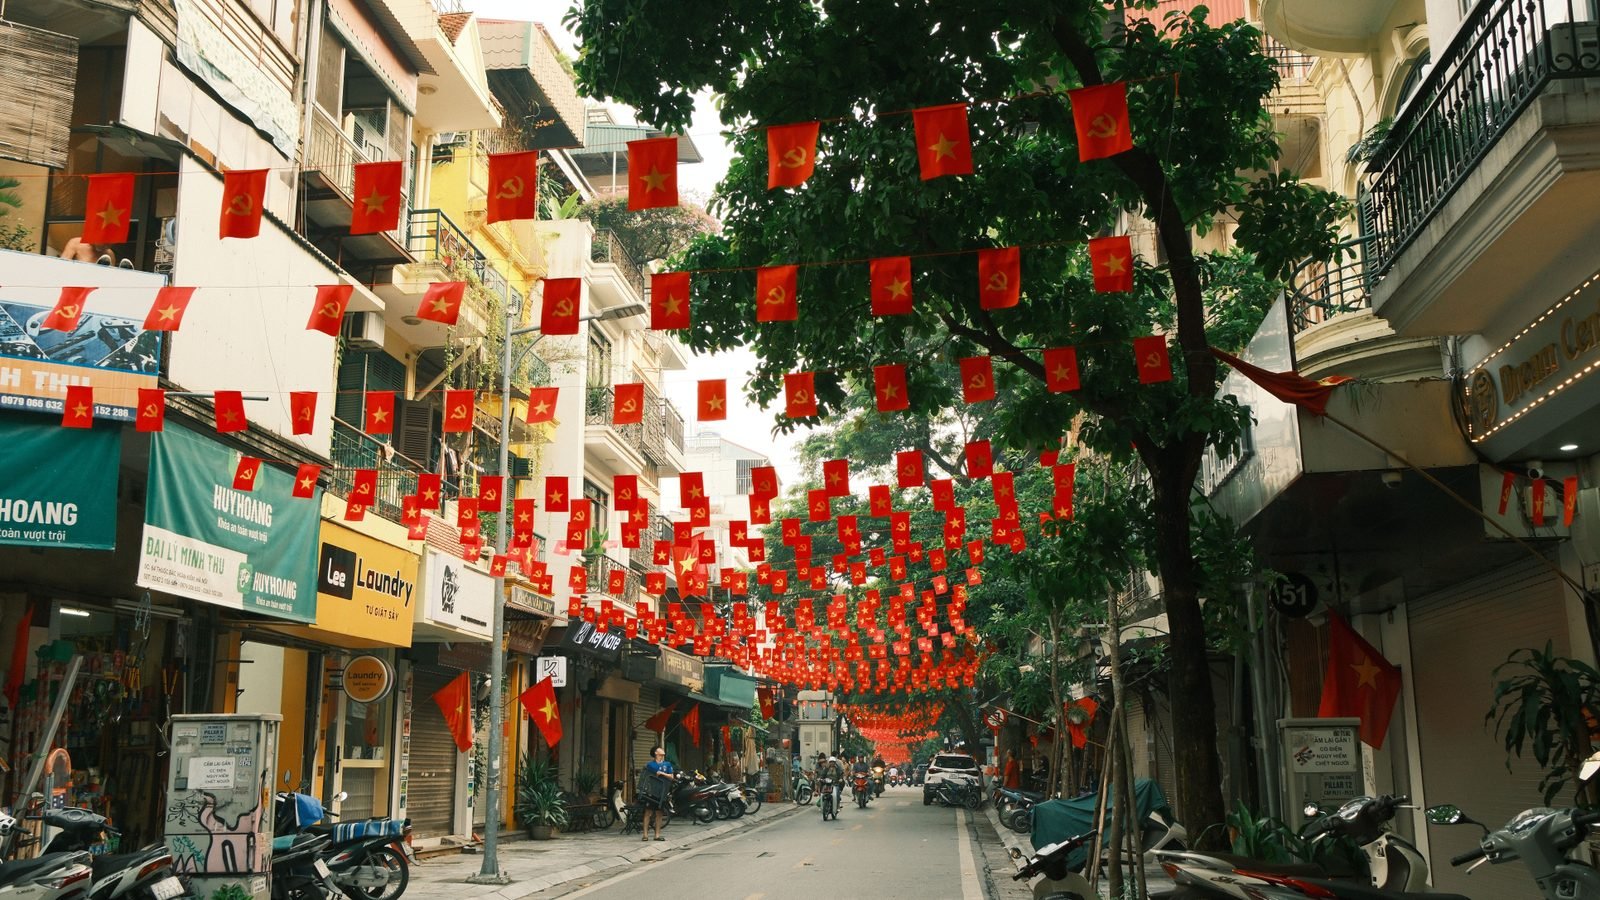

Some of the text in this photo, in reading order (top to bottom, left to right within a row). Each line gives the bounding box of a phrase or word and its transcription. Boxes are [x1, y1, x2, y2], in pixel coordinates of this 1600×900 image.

[1499, 304, 1600, 405] Dream Cen
[0, 395, 24, 406] 0979
[45, 400, 63, 410] 632
[94, 405, 111, 417] 152
[213, 484, 273, 528] HUYHOANG
[23, 530, 46, 542] vượt
[48, 531, 66, 543] trội
[145, 536, 165, 563] ĐẠI
[180, 546, 205, 571] MINH
[207, 554, 225, 575] THU
[252, 571, 297, 600] HUYHOANG
[327, 557, 346, 588] Lee
[356, 558, 413, 608] Laundry
[1281, 584, 1306, 606] 51
[348, 671, 382, 681] Laundry
